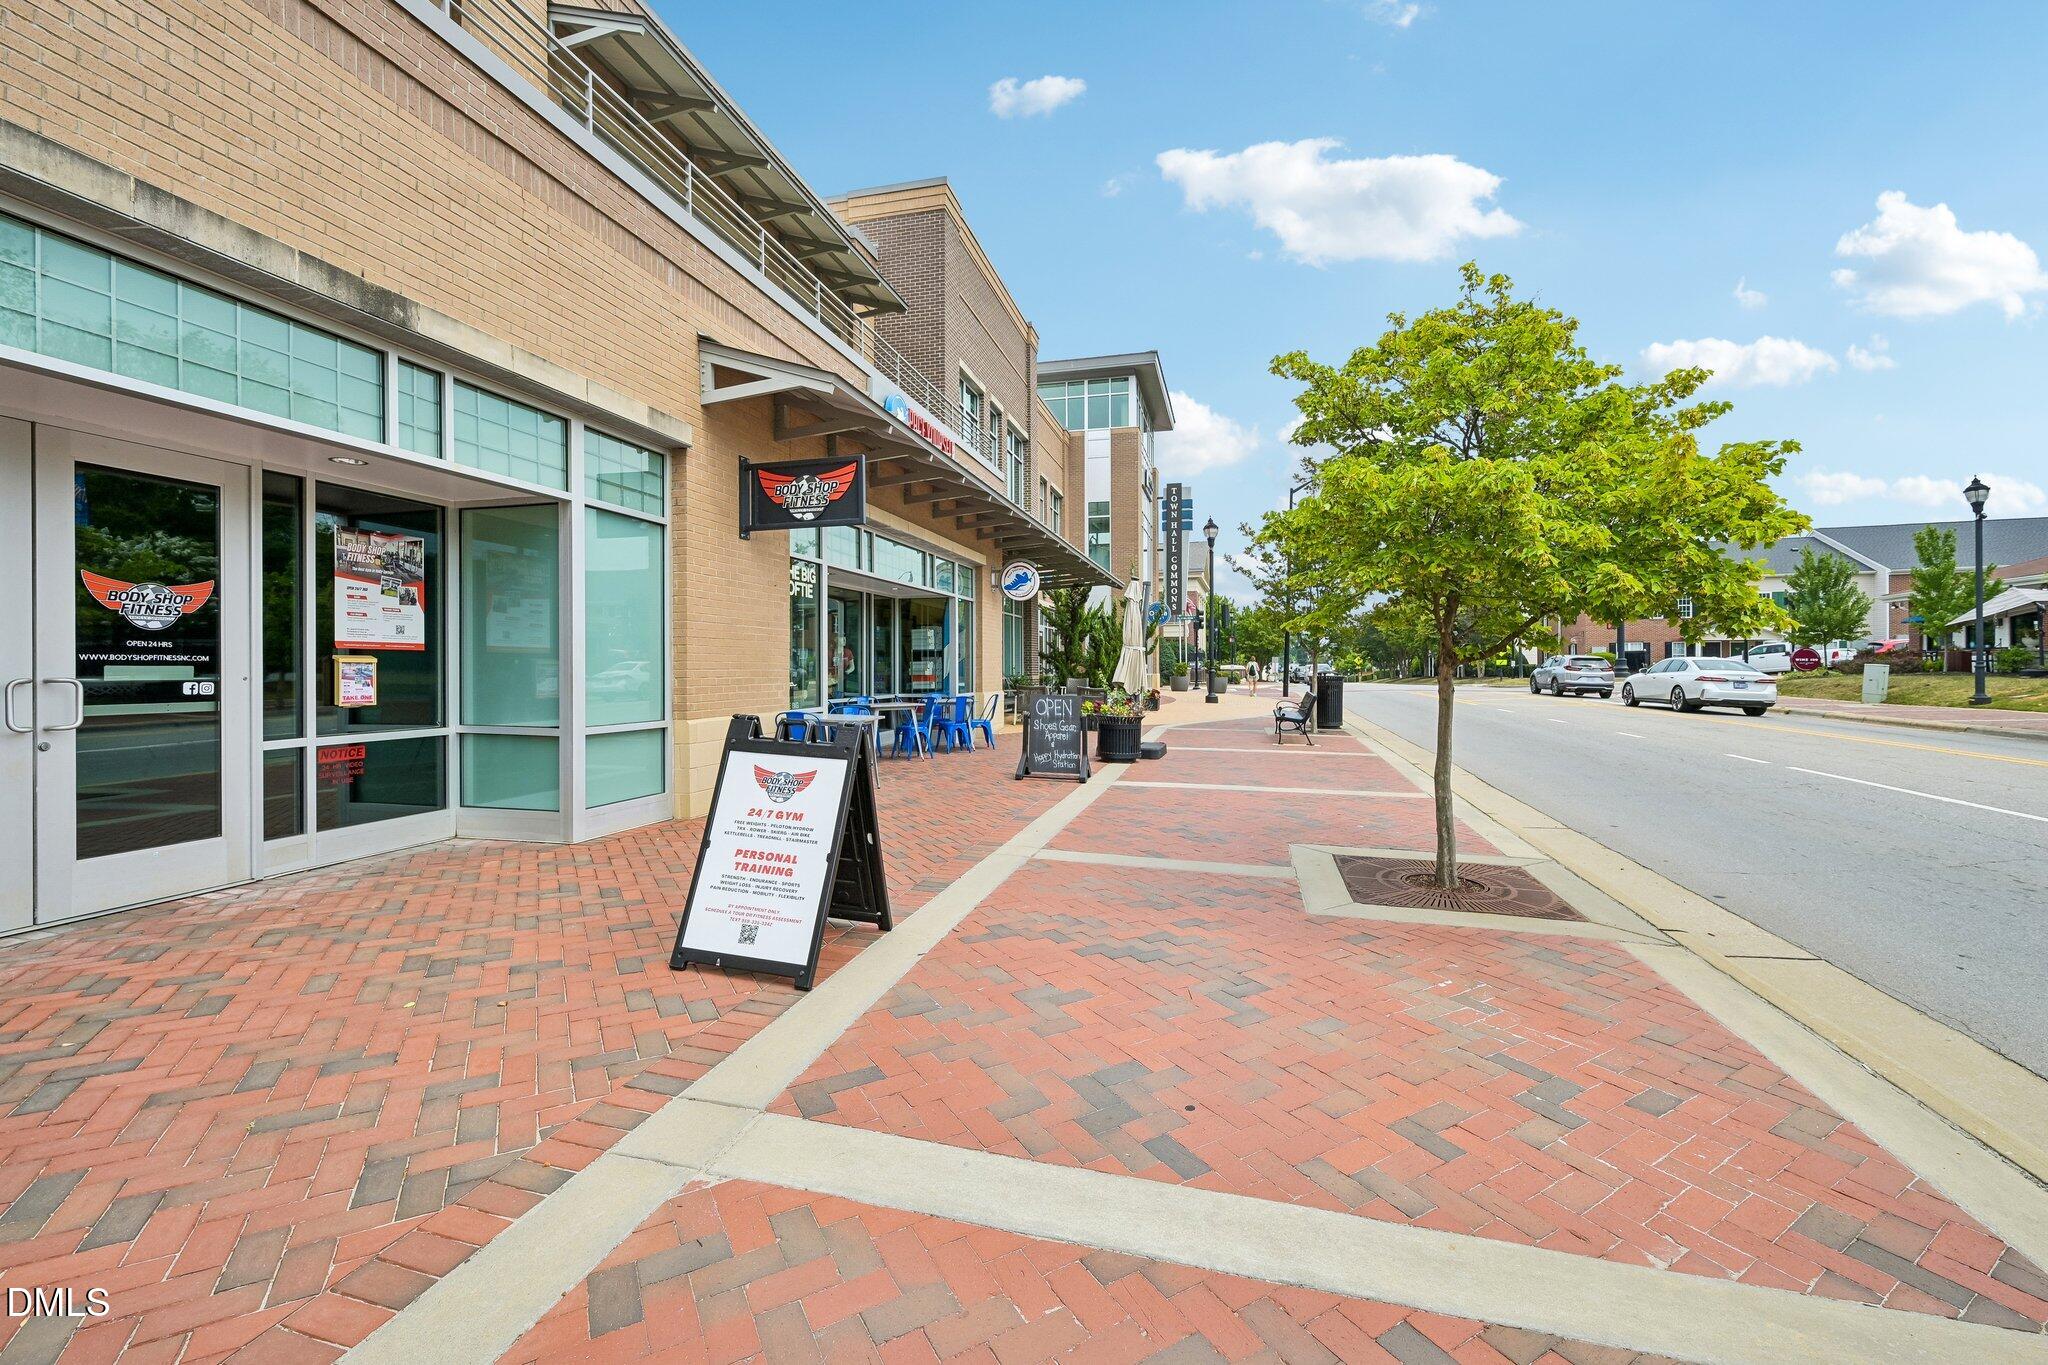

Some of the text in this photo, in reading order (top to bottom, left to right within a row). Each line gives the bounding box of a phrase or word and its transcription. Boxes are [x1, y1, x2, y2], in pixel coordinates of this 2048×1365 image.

[774, 481, 838, 496] BODY SHOP
[782, 494, 829, 508] FITNESS
[346, 542, 386, 556] BODY SHOP
[1170, 487, 1178, 611] TOWN HALL COMMONS
[346, 552, 376, 565] FITNESS
[801, 566, 816, 584] BIG
[107, 590, 194, 606] BODY SHOP
[119, 602, 182, 616] FITNESS
[79, 654, 209, 662] WWW.BODYSHOPFITNESSNC.COM
[1035, 697, 1073, 717] OPEN
[1044, 731, 1069, 741] Apparel
[320, 747, 364, 760] NOTICE
[1033, 749, 1081, 763] Happy Hydration
[1052, 760, 1076, 768] Station
[762, 776, 804, 787] BODY SHOP
[765, 784, 796, 795] FITNESS
[748, 807, 804, 822] 24/7 GYM
[724, 830, 753, 838] KETTLEBELLS
[785, 837, 818, 845] STAIRMASTER
[734, 848, 798, 865] PERSONAL
[734, 861, 794, 878] TRAINING
[721, 873, 746, 881] STRENGTH
[749, 877, 778, 885] ENDURANCE
[721, 886, 749, 894] REDUCTION
[778, 893, 805, 901] FLEXIBILITY
[773, 886, 798, 894] RECOVERY
[705, 906, 728, 914] SCHEDULE
[772, 916, 802, 924] ASSESSMENT
[735, 904, 767, 913] APPOINTMENT
